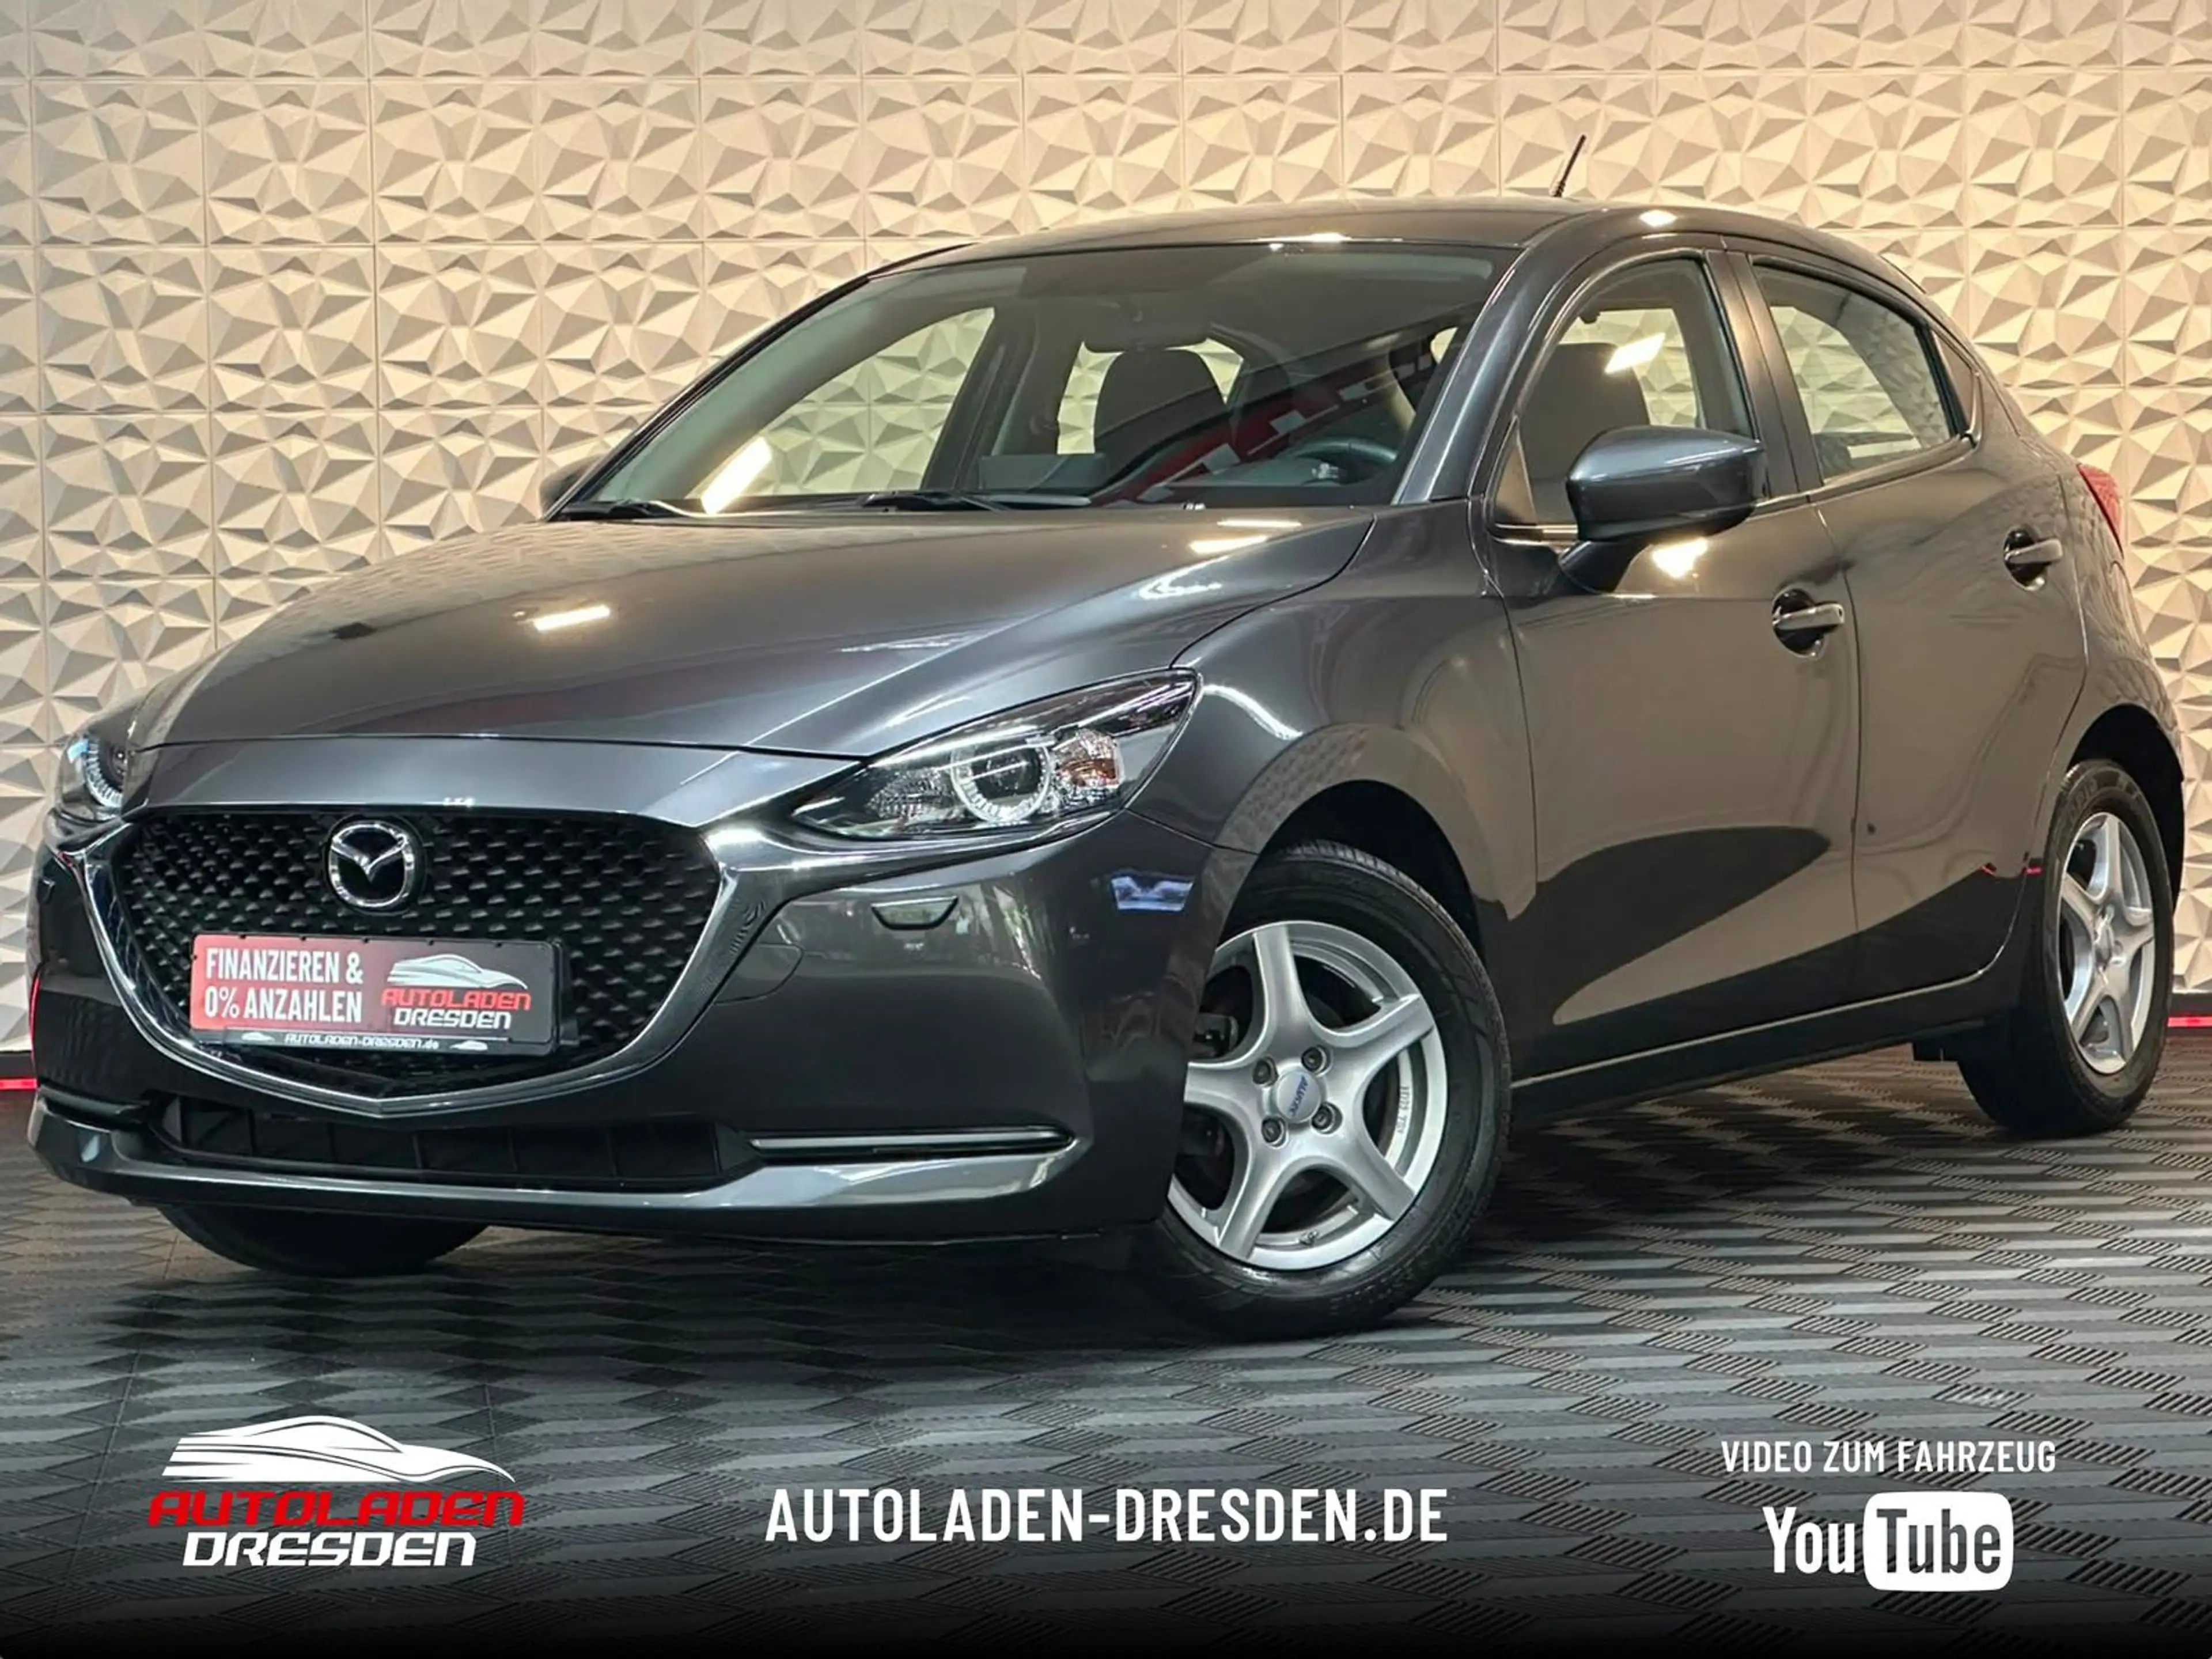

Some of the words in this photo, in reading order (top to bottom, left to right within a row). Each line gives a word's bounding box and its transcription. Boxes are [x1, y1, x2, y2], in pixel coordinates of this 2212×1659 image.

[206, 948, 339, 983] FINANZIEREN
[346, 952, 363, 984] &
[204, 986, 240, 1018] 0%
[243, 987, 362, 1023] ANZAHLEN
[381, 988, 531, 1011] AUTOLADEN
[393, 1007, 512, 1030] DRESDEN
